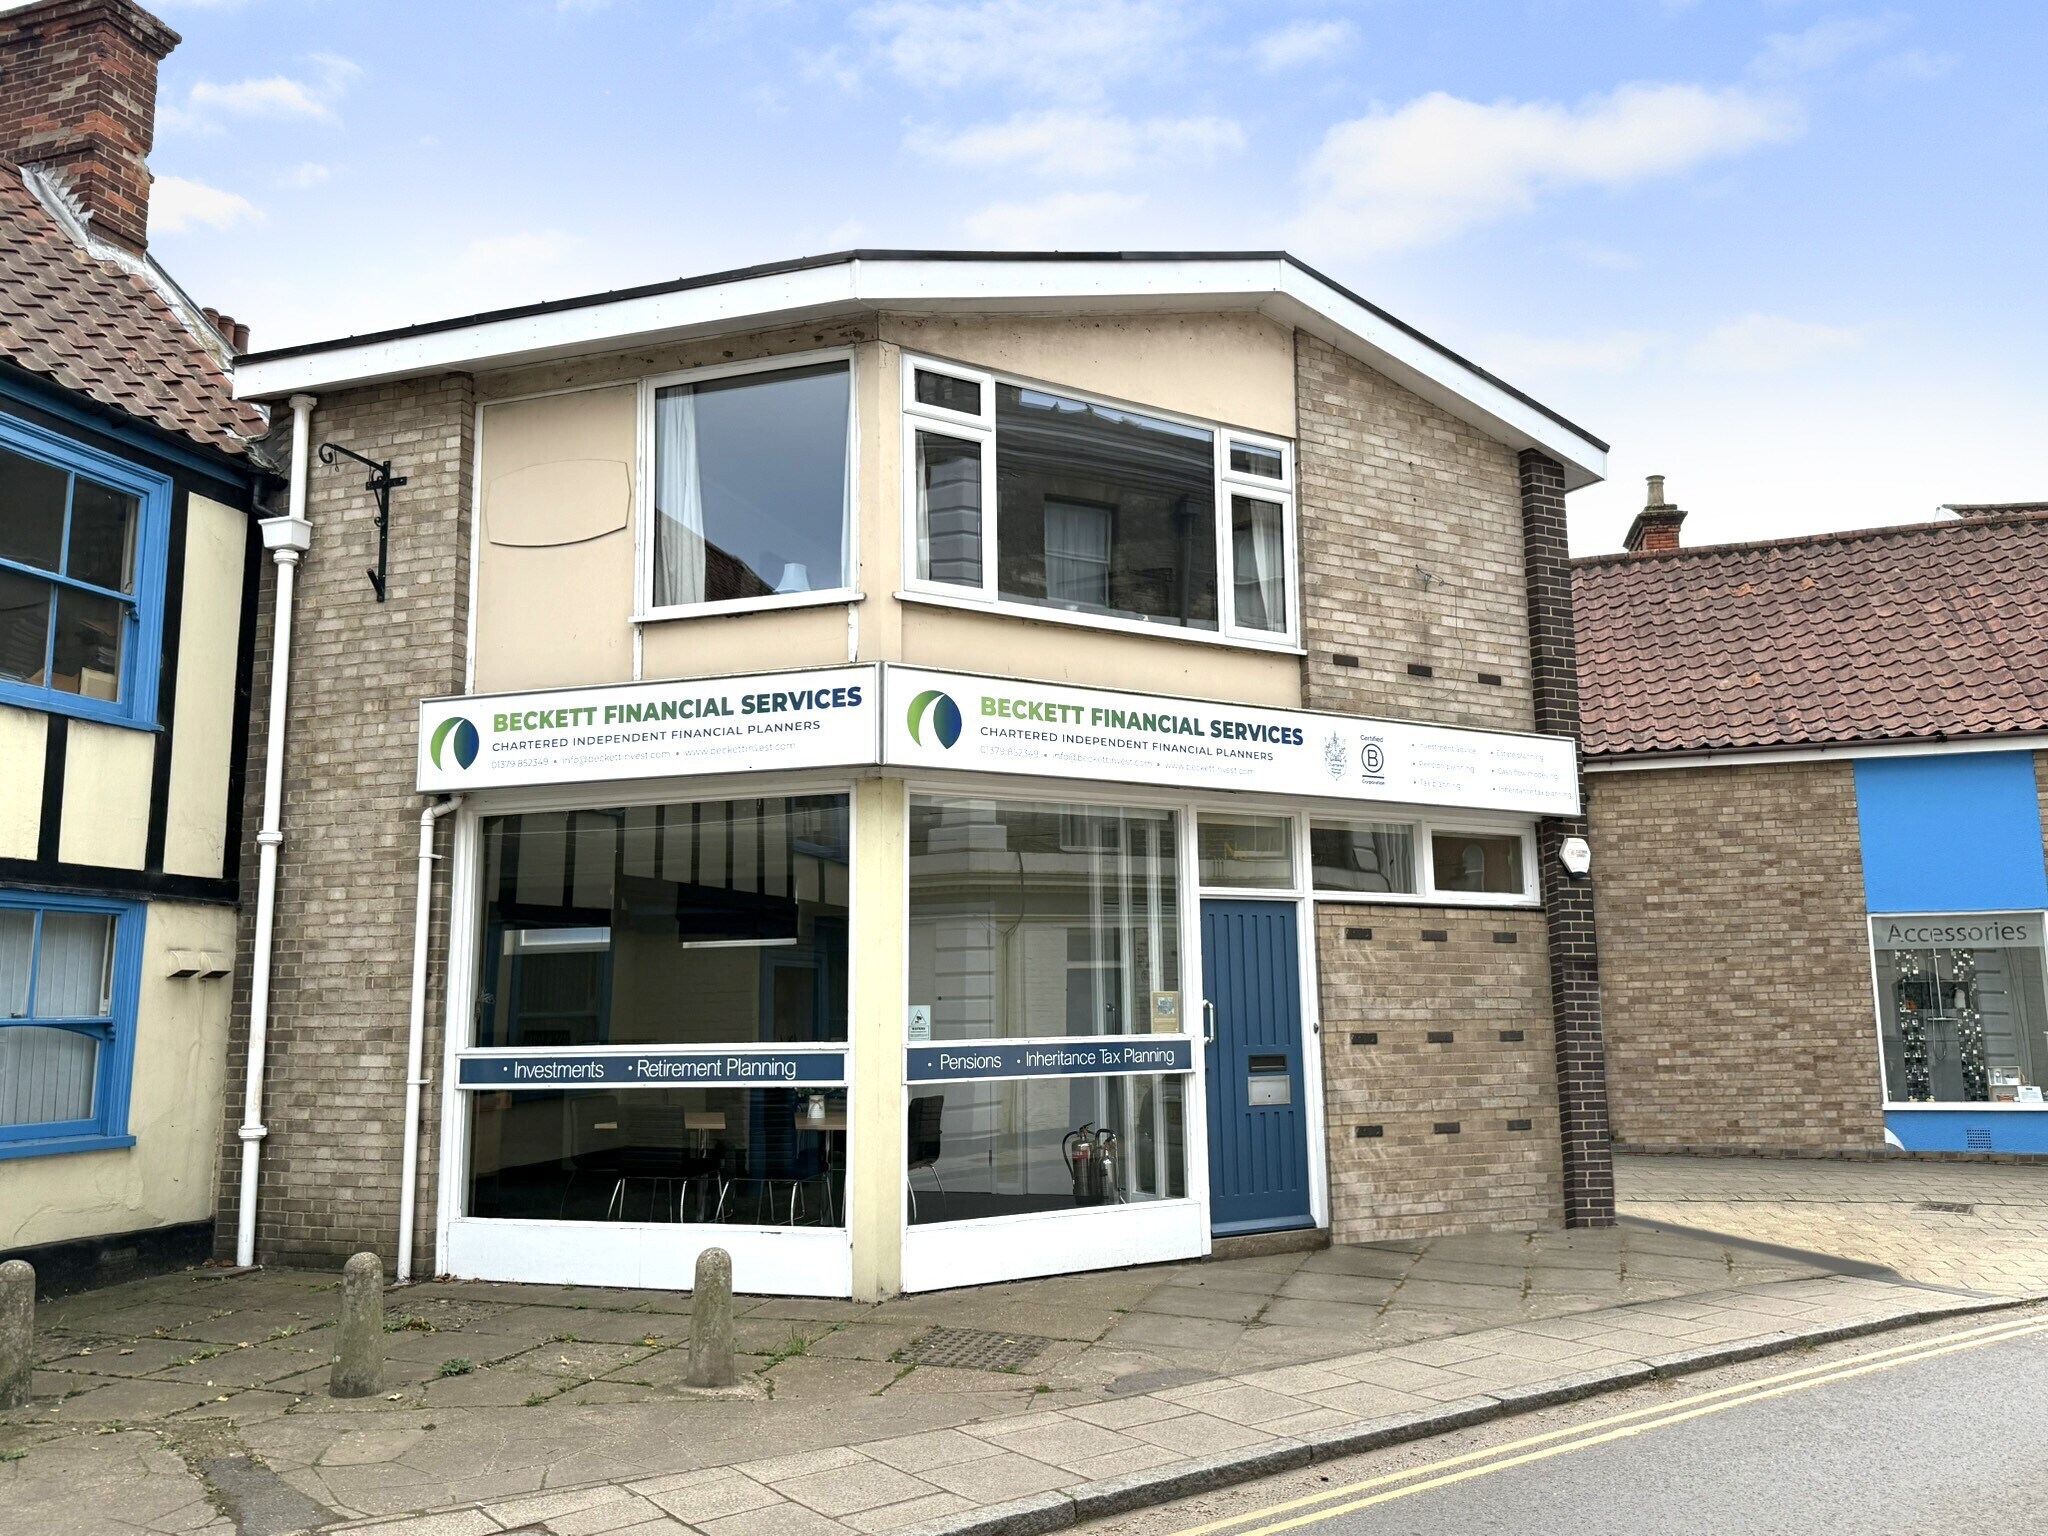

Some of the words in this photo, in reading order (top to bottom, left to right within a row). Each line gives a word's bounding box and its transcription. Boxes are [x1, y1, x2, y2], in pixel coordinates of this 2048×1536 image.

[493, 706, 597, 733] BECKETT
[604, 697, 734, 724] FINANCIAL
[741, 686, 863, 715] SERVICES
[980, 696, 1085, 725] BECKETT
[1091, 708, 1205, 737] FINANCIAL
[1210, 719, 1304, 746] SERVICES
[492, 737, 568, 753] CHARTERED
[573, 730, 666, 747] INDEPENDENT
[671, 726, 743, 740] FINANCIAL
[747, 720, 821, 734] PLANNERS
[980, 726, 1058, 743] CHARTERED
[1062, 734, 1149, 750] INDEPENDENT
[1152, 742, 1213, 756] FINANCIAL
[1216, 748, 1274, 761] PLANNERS
[1360, 734, 1384, 743] Certified
[1367, 749, 1379, 767] B
[1420, 743, 1454, 753] nvestment
[491, 758, 518, 770] 01379
[562, 750, 671, 765] info@beckettnvest.com
[1165, 762, 1256, 776] www.beckettnvest.com
[1887, 921, 2028, 944] Accessories
[939, 1053, 1002, 1071] Pensions
[1025, 1049, 1096, 1067] Inheritance
[1099, 1048, 1121, 1065] Tax
[1123, 1046, 1175, 1067] Planning
[514, 1060, 605, 1079] Investments
[636, 1059, 722, 1077] Retirement
[726, 1057, 797, 1080] Planning
